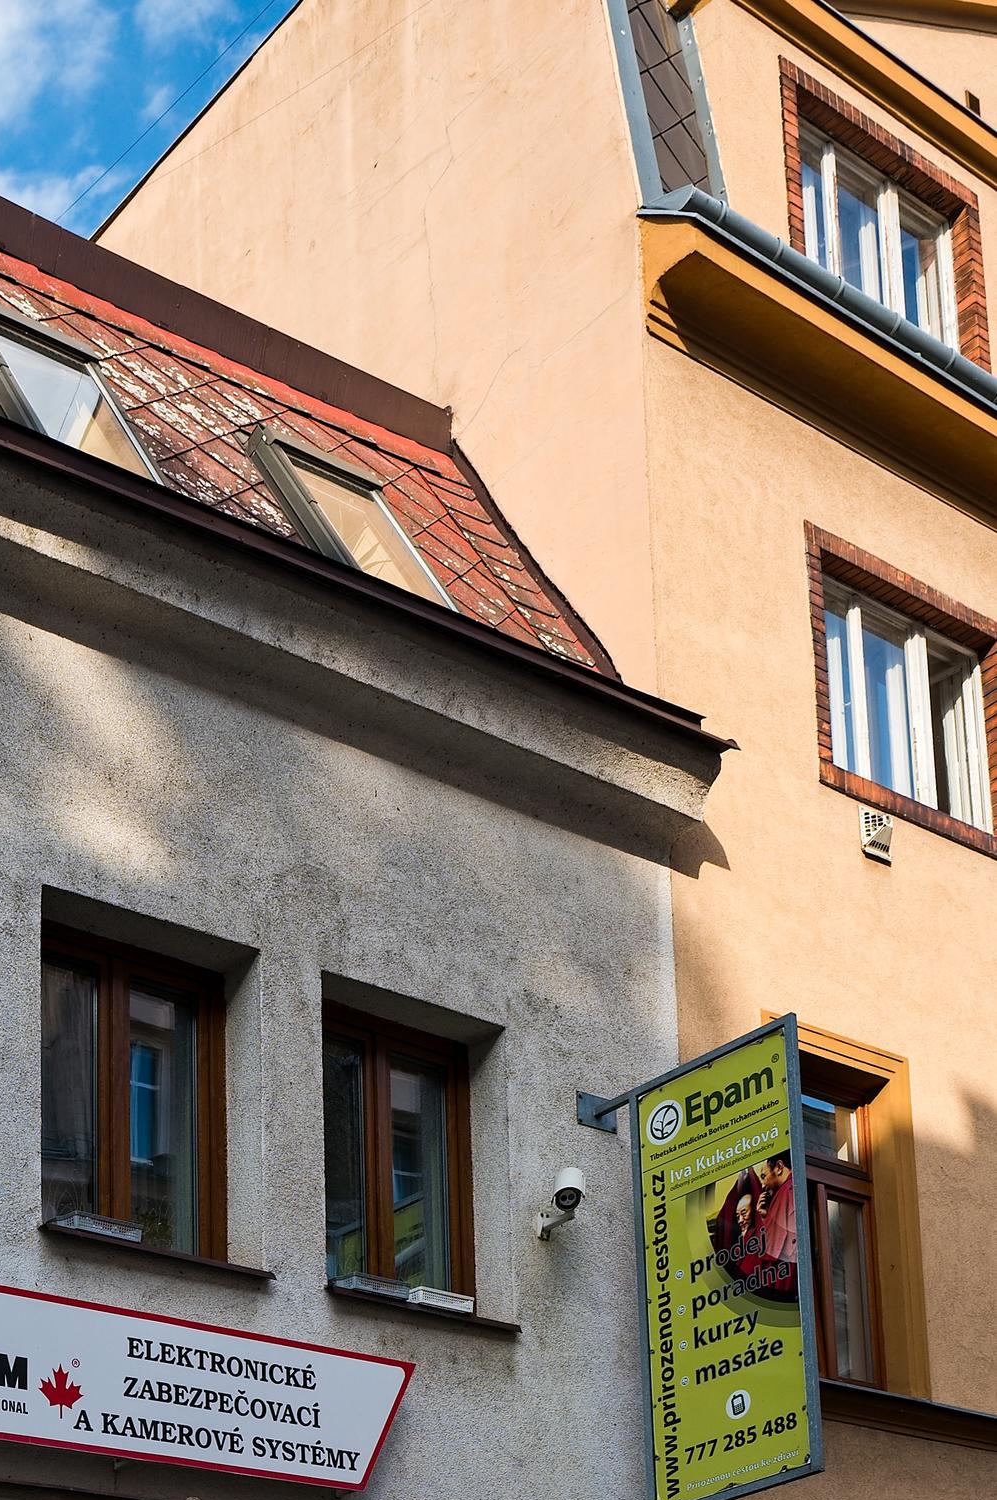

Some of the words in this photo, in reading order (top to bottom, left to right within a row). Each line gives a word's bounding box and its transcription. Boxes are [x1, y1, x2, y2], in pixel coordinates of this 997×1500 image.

[685, 1066, 774, 1128] Epam
[669, 1166, 693, 1184] Iva
[695, 1124, 779, 1171] Kukačková
[689, 1227, 767, 1283] prodej
[691, 1260, 791, 1318] poradna
[652, 1170, 681, 1499] www.prirozenou-cestou.cz
[694, 1310, 759, 1349] kurzy
[126, 1336, 317, 1391] ELEKTRONICKÉ
[695, 1337, 783, 1385] masáže
[122, 1376, 320, 1429] ZABEZPEČOVACÍ
[73, 1409, 94, 1432] A
[100, 1411, 244, 1454] KAMEROVÉ
[252, 1437, 361, 1472] SYSTÉMY
[684, 1438, 718, 1464] 777
[722, 1425, 757, 1452] 285
[761, 1411, 797, 1437] 488
